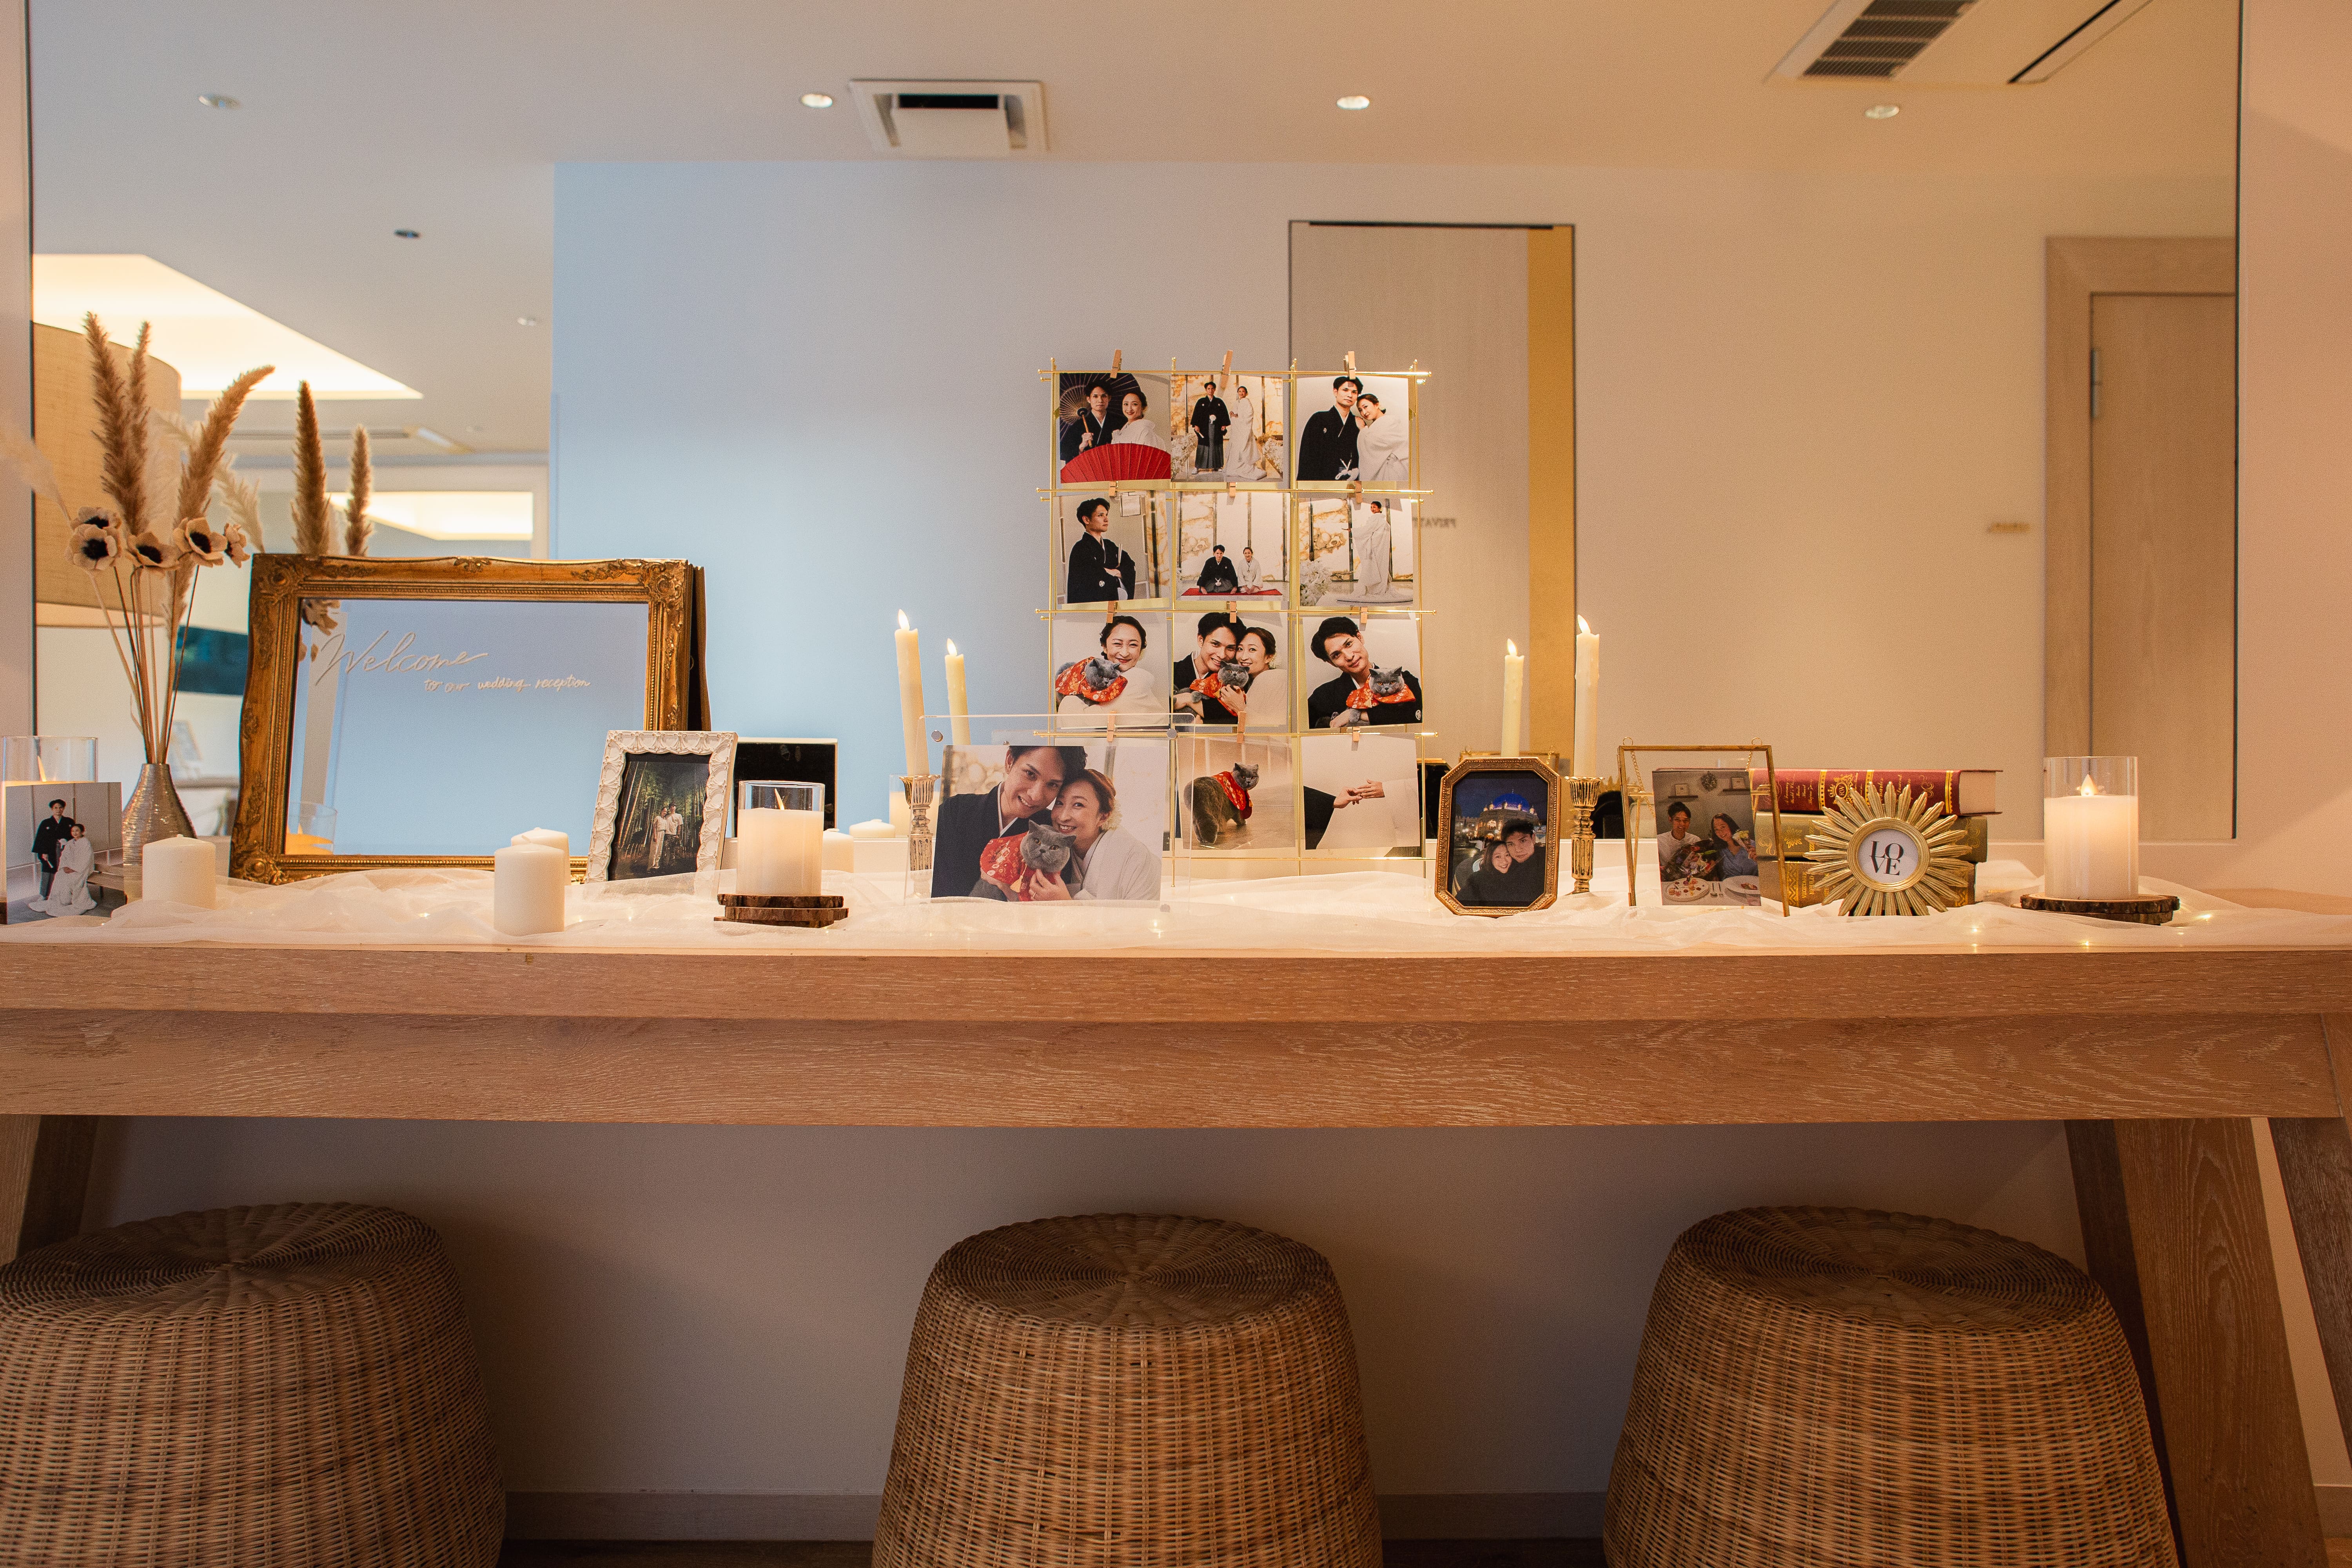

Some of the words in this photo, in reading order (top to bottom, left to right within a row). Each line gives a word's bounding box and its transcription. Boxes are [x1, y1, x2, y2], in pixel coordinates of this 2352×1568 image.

[315, 630, 489, 686] Welcome
[424, 679, 443, 691] to
[445, 682, 470, 693] our
[478, 676, 531, 693] wedding
[535, 674, 591, 692] reception
[1838, 785, 1845, 795] RW
